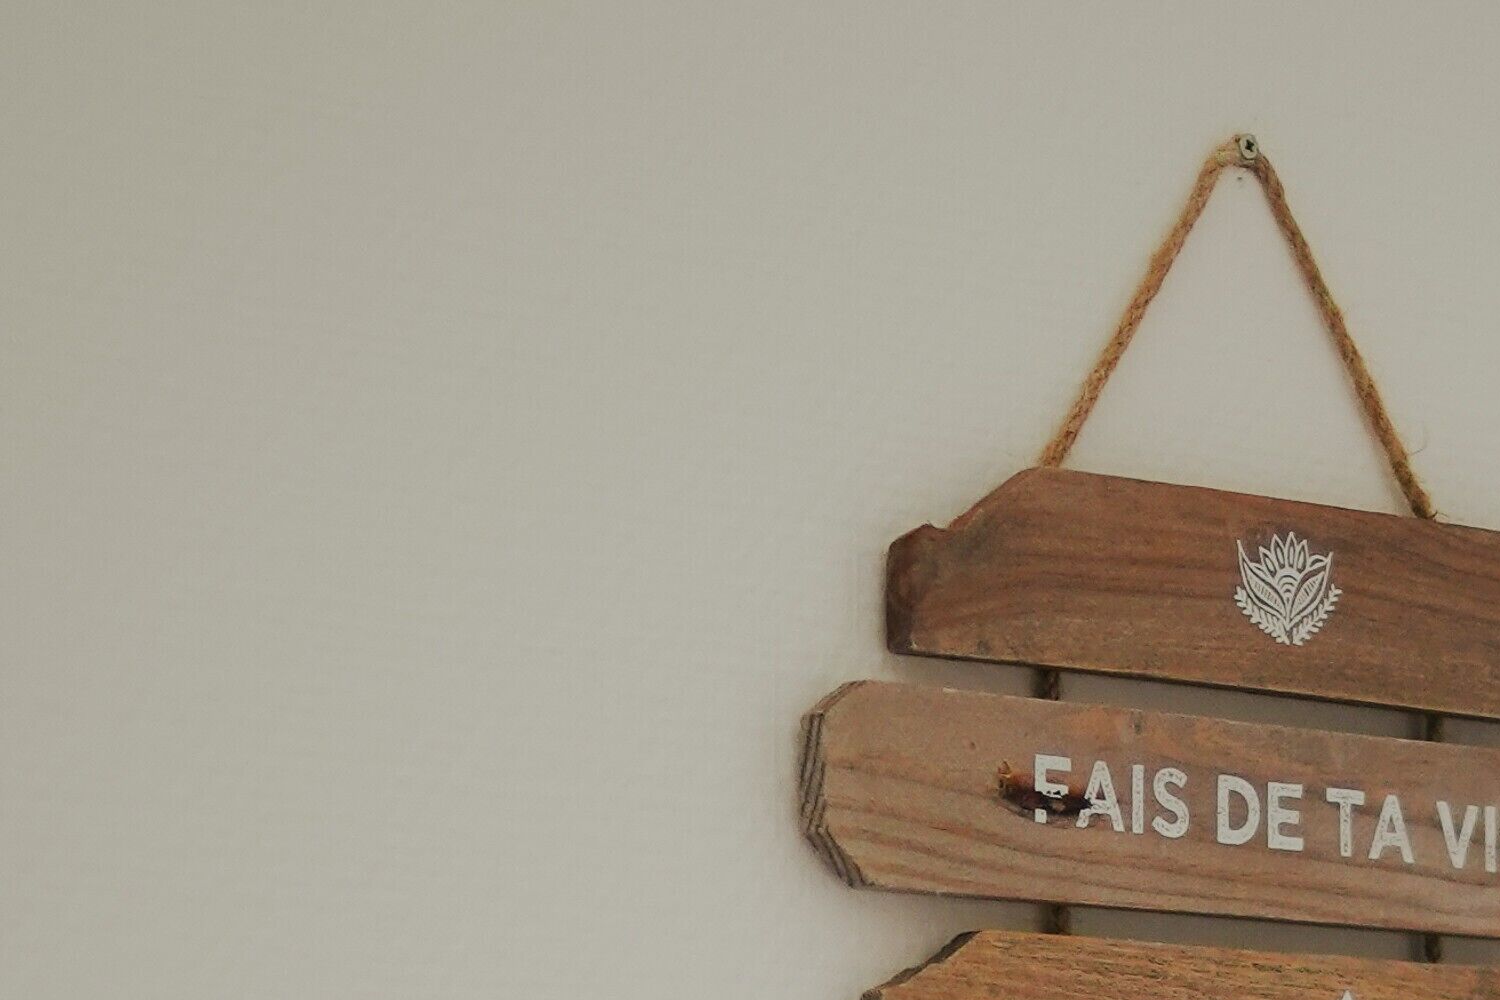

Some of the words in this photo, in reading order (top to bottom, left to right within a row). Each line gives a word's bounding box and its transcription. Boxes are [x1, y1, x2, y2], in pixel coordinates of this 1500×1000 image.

[1033, 753, 1190, 838] FAIS
[1216, 774, 1303, 852] DE
[1326, 787, 1415, 864] TA
